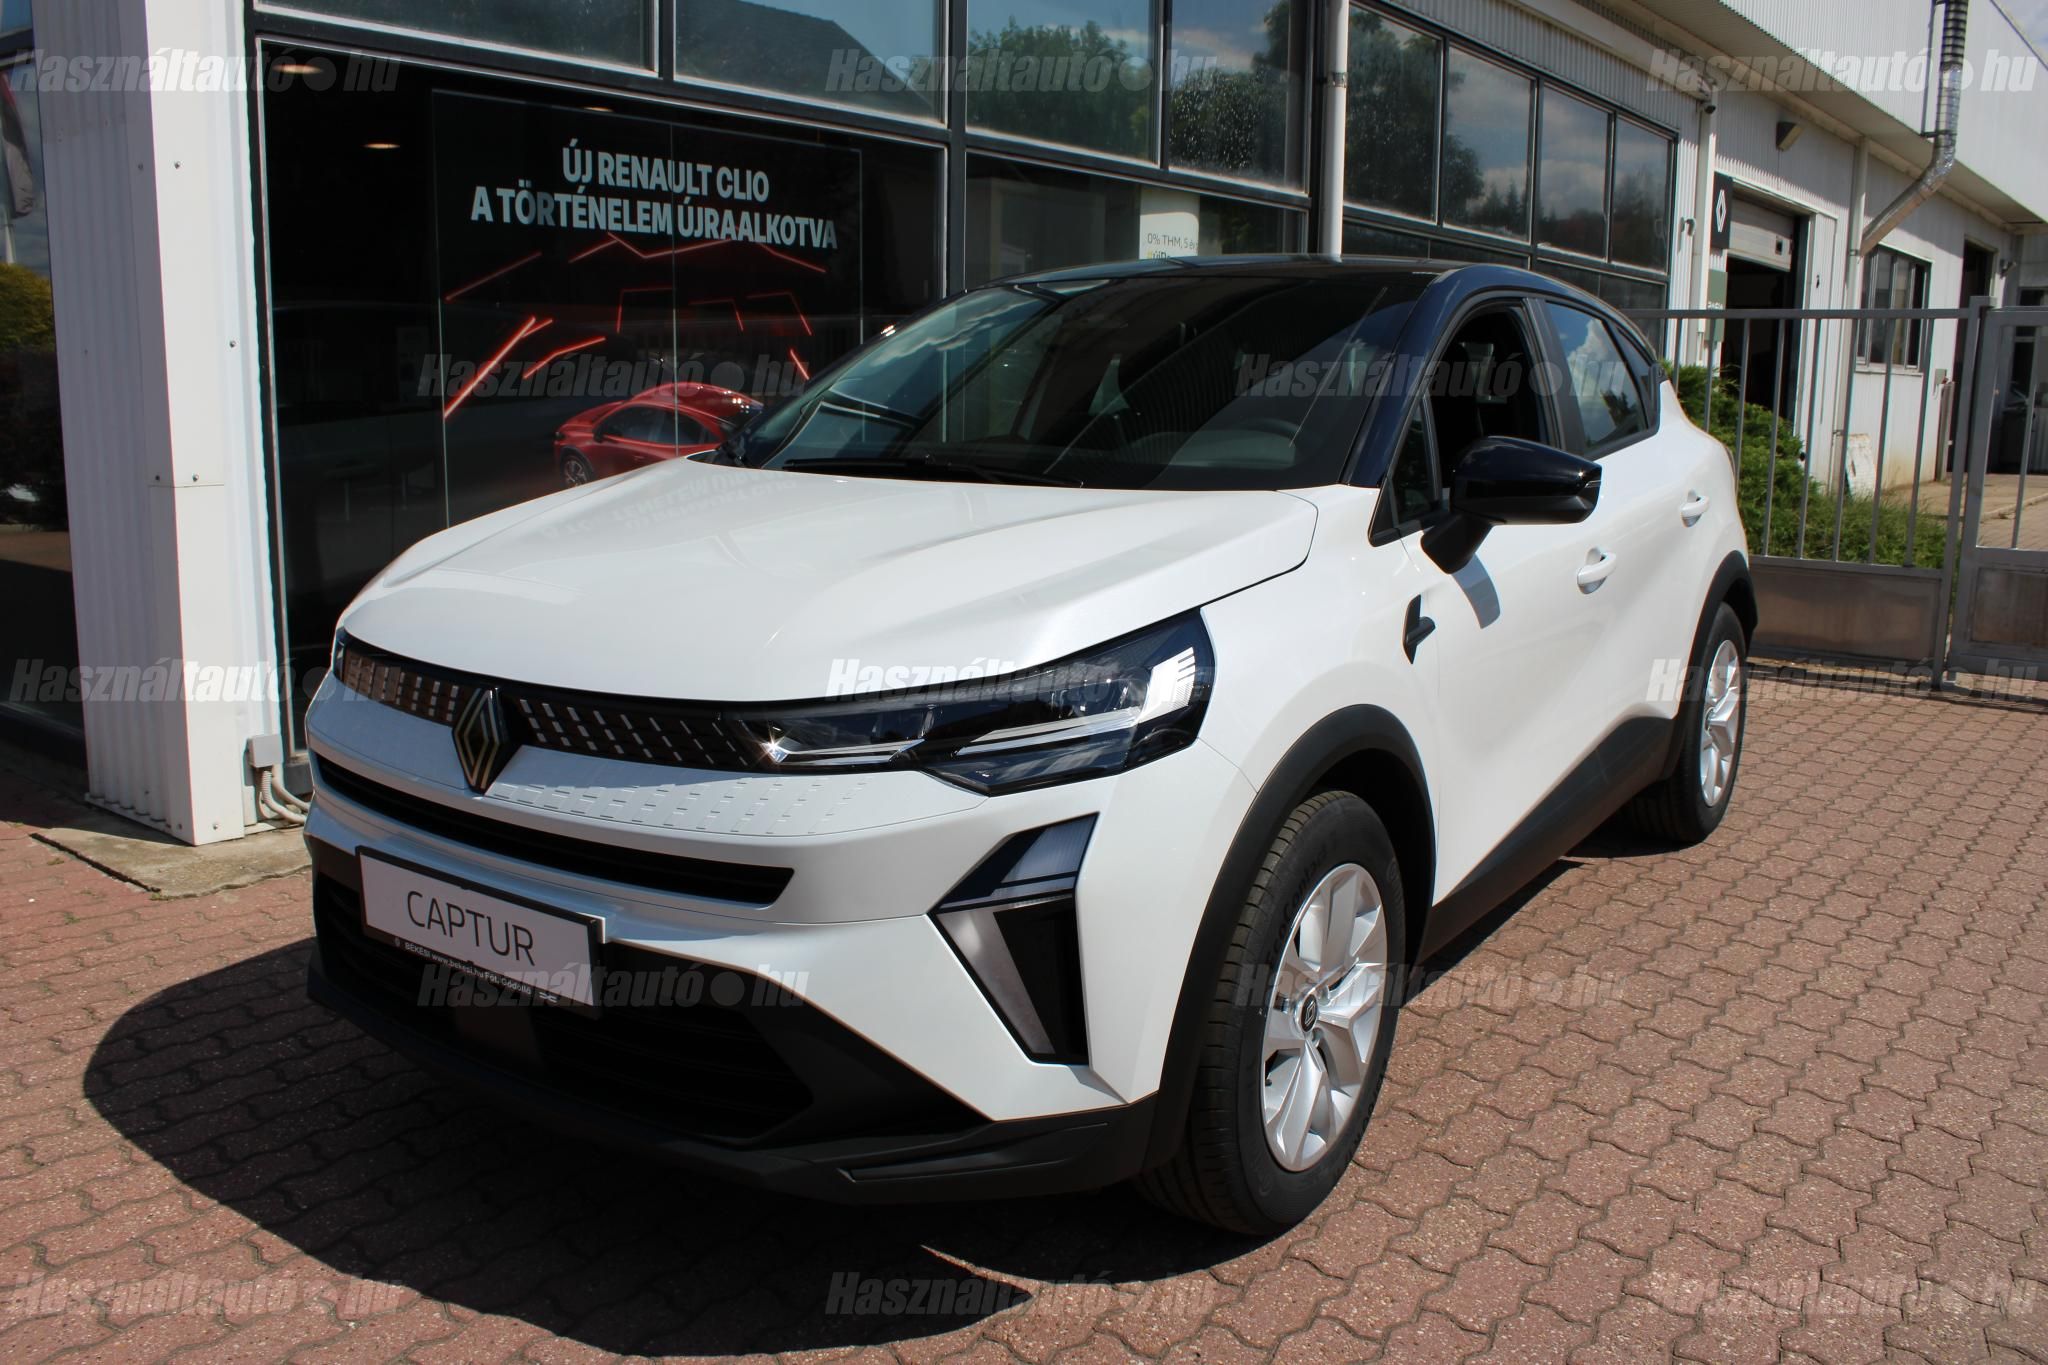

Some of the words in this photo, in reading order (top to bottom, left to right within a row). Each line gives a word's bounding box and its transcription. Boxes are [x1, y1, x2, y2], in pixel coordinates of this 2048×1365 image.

[563, 138, 592, 183] ÚJ
[598, 152, 712, 197] RENAULT
[716, 166, 770, 202] CLIO
[470, 186, 493, 222] A
[497, 179, 673, 235] TÖRTÉNELEM
[677, 197, 839, 250] ÚJRAALKOTVA
[1147, 233, 1160, 245] 0%
[407, 890, 535, 966] CAPTUR
